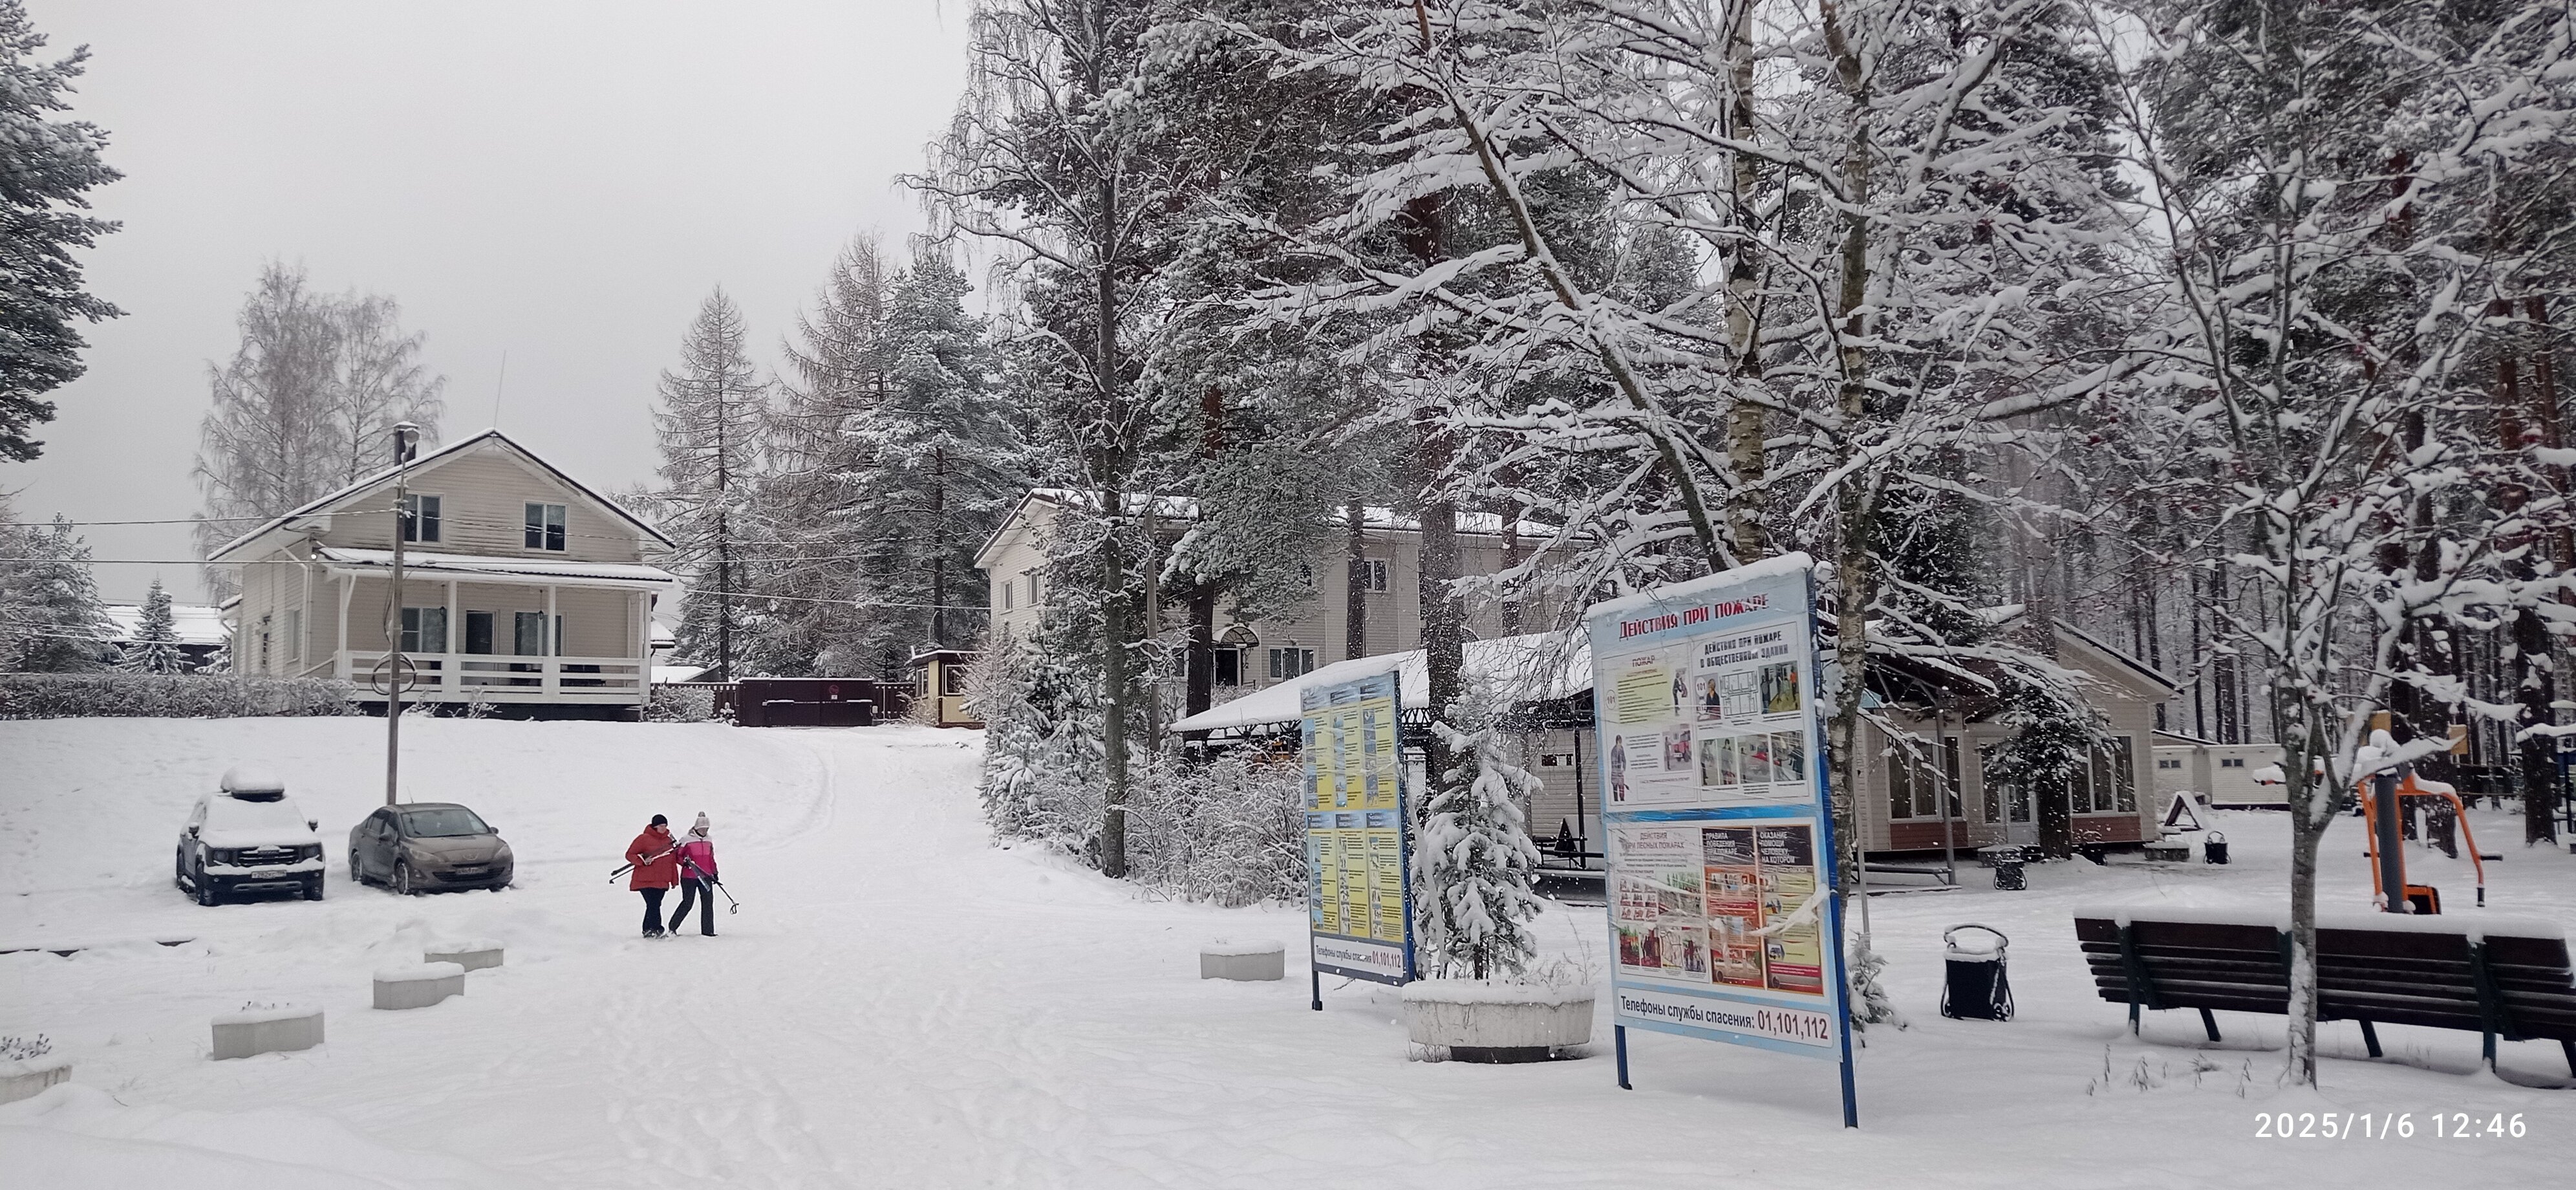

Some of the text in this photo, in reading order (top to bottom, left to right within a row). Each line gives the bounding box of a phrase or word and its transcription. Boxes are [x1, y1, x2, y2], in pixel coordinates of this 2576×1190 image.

[1683, 607, 1709, 626] ПРИ
[1715, 593, 1769, 619] ПОЖАРЕ
[1705, 631, 1782, 655] ДЕЙСТВИЯ ПРИ ПОЖАРЕ
[1632, 655, 1655, 667] ПОЖАР
[1336, 949, 1351, 961] службы
[1372, 951, 1401, 969] 01,101,112
[1620, 995, 1828, 1040] Телефоны службы спасения: 01,101,112
